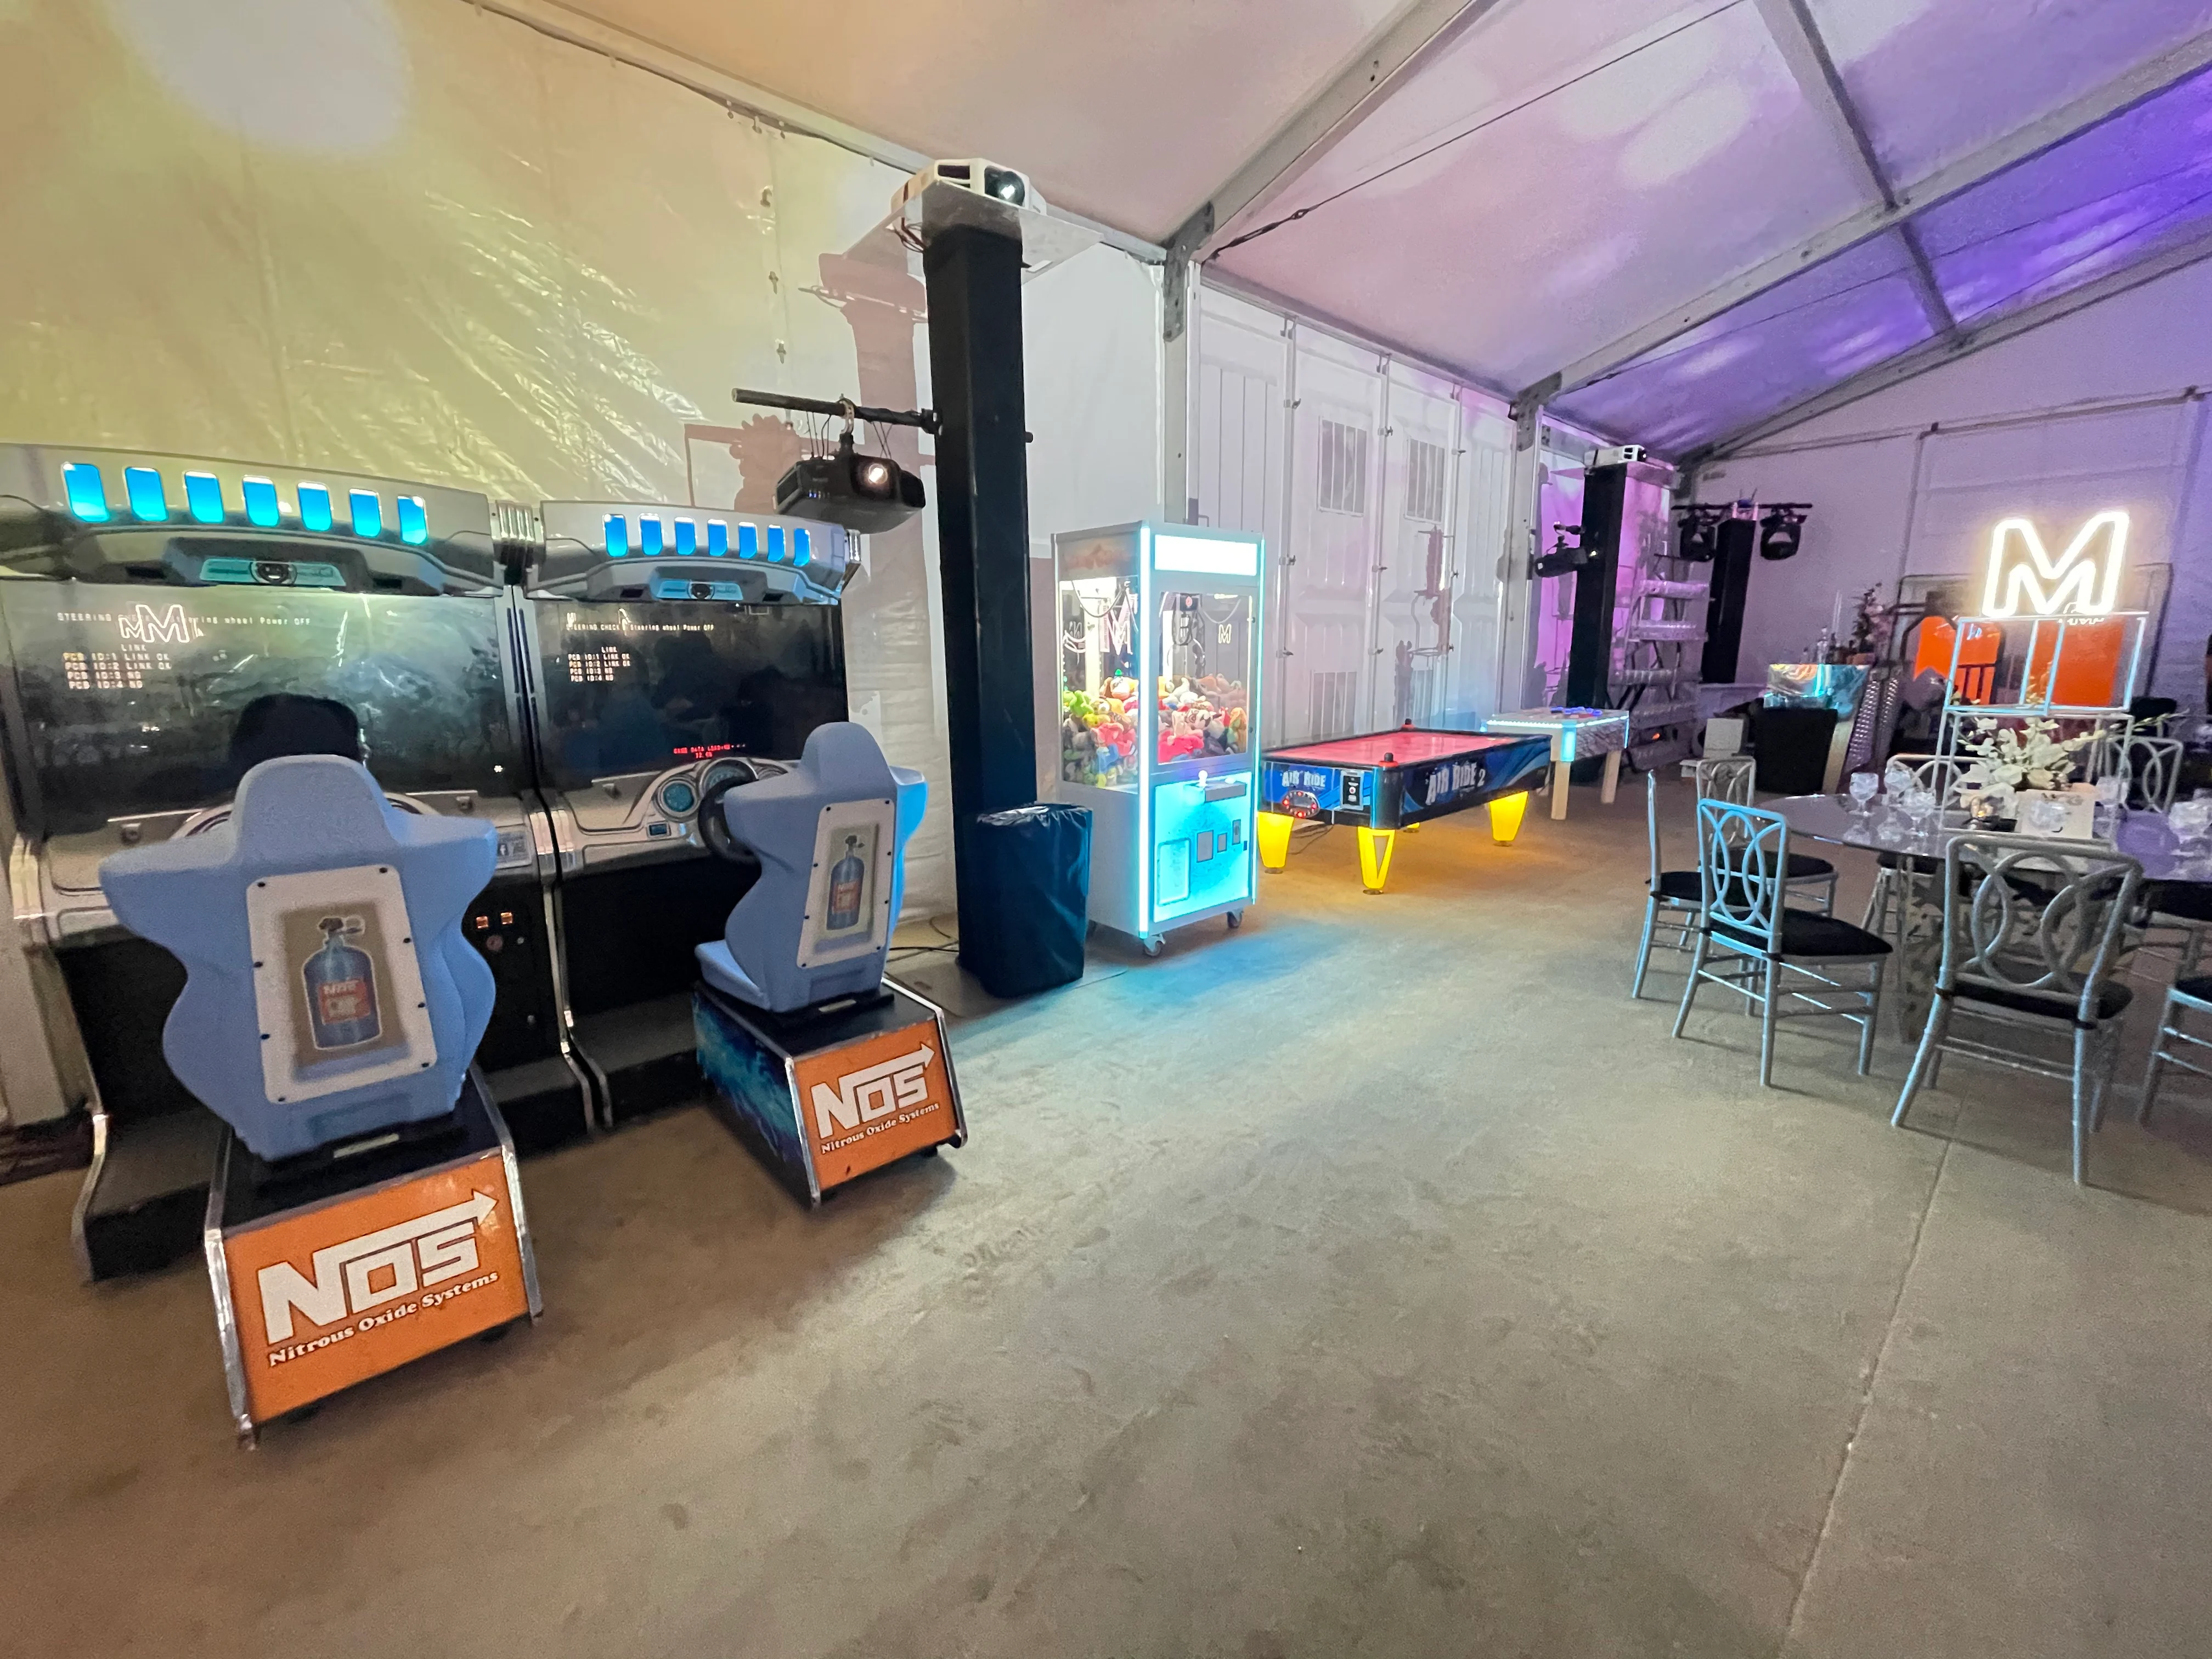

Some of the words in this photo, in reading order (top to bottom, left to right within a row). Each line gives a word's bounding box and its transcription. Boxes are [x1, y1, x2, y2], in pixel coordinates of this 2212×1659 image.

[1982, 511, 2130, 618] M
[57, 612, 112, 622] STEERING
[63, 652, 86, 661] PCB
[92, 652, 117, 661] ID:1
[124, 652, 150, 661] LINK
[156, 653, 171, 661] OK
[121, 644, 147, 652] LINK
[65, 662, 88, 670] PCB
[93, 662, 120, 671] ID:2
[126, 662, 153, 670] LINK
[158, 662, 172, 670] OK
[67, 671, 88, 680] PCB
[69, 681, 90, 690] PCB
[1282, 770, 1300, 787] AIR
[1304, 771, 1326, 788] RIDE
[1425, 768, 1449, 805] AIR
[1452, 761, 1477, 791] RIDE
[1477, 769, 1486, 787] 2
[811, 1047, 931, 1139] NOS
[821, 1132, 865, 1155] Nitrous
[866, 1120, 897, 1137] Oxide
[899, 1102, 940, 1124] Systems
[258, 1196, 484, 1345] NOS
[268, 1327, 355, 1368] Nitrous
[358, 1302, 418, 1333] Oxide
[421, 1272, 499, 1309] Systems
